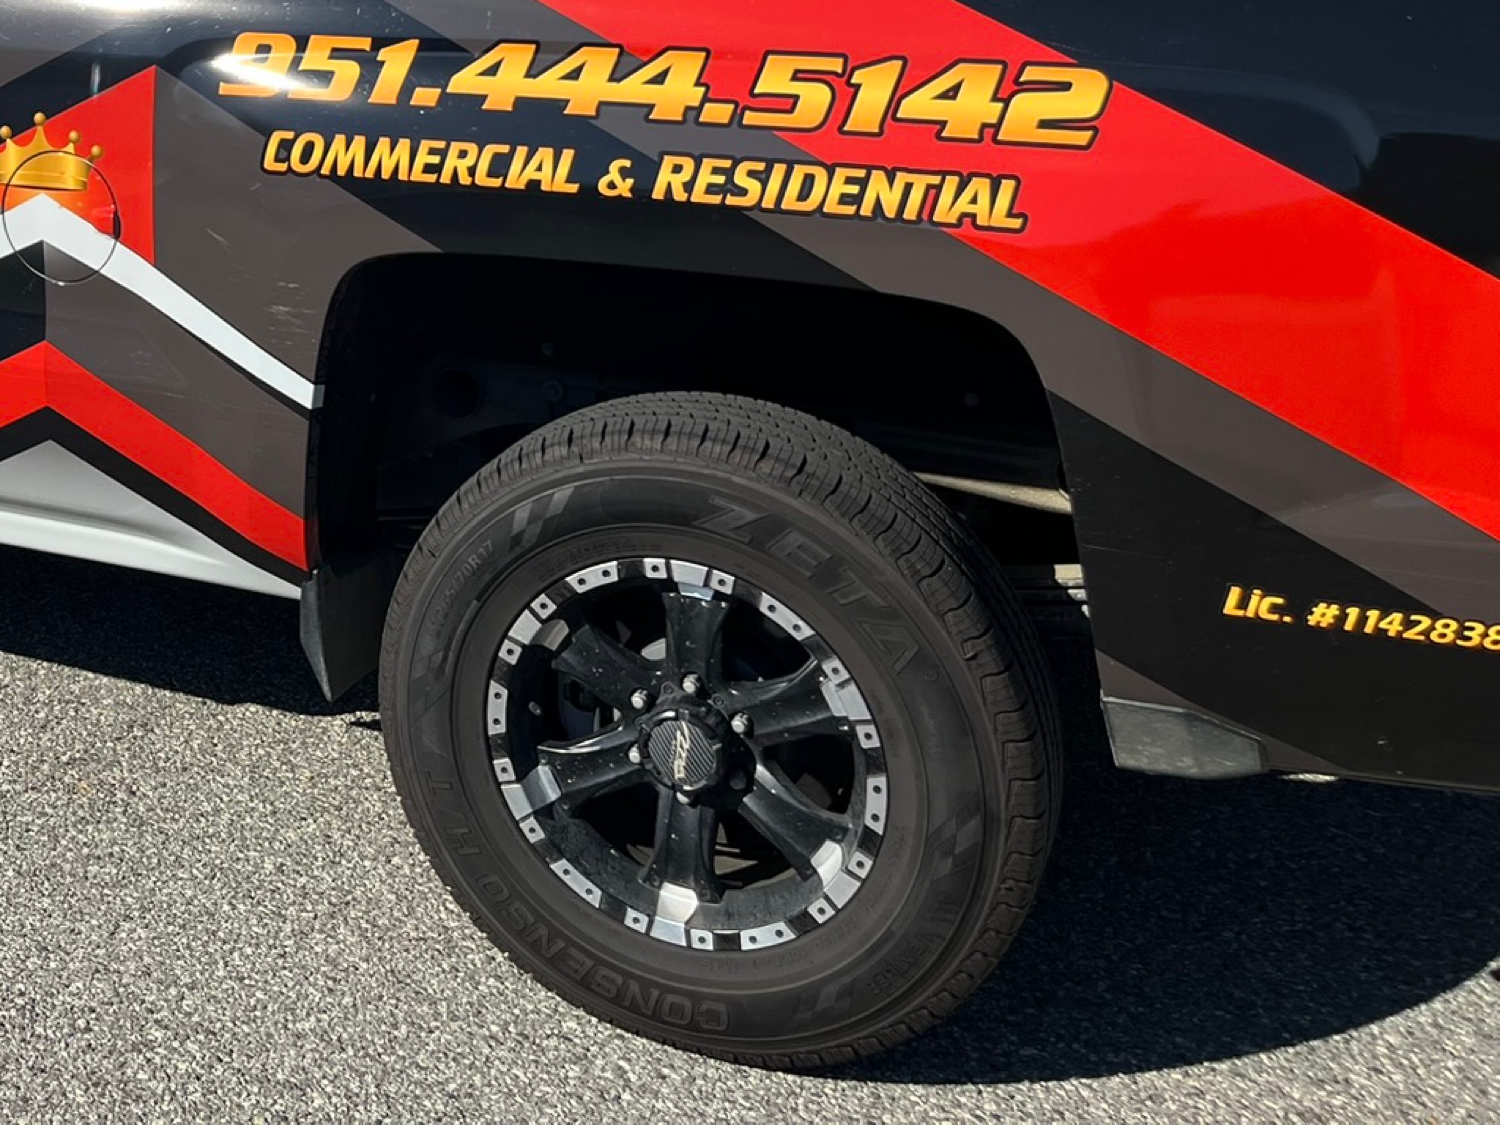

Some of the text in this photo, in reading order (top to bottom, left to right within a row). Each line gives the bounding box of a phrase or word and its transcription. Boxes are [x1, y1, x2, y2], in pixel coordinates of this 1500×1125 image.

[215, 28, 1112, 149] 951.444.5142
[261, 128, 1029, 232] COMMERCIAL & RESIDENTIAL
[690, 493, 922, 677] ZETA
[1221, 584, 1500, 651] Lic. #1142838
[475, 872, 731, 1032] CONSENSO
